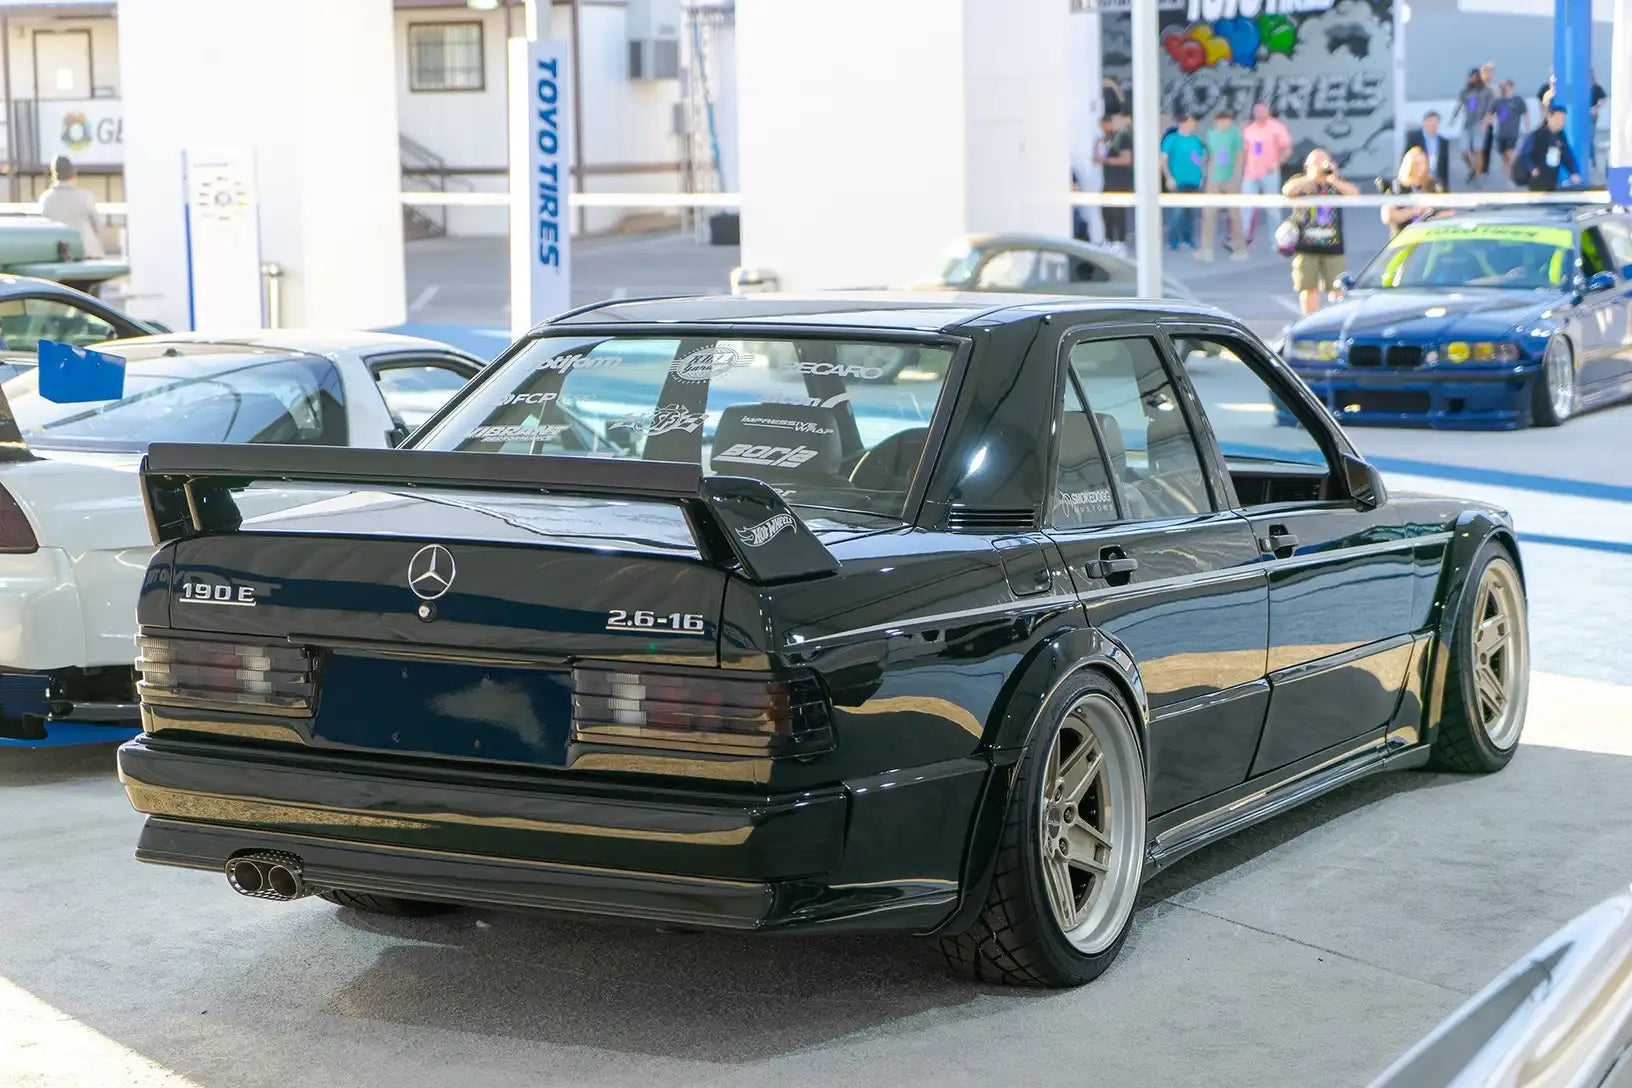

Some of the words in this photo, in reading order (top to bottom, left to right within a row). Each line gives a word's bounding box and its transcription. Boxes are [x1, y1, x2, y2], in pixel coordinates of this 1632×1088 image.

[537, 58, 558, 155] TOYO
[539, 163, 559, 267] TIRES
[530, 353, 624, 374] otiform
[511, 392, 557, 405] FCP
[751, 525, 769, 545] HOT
[182, 582, 231, 601] 190
[238, 587, 255, 602] E
[607, 609, 704, 630] 2.6-16
